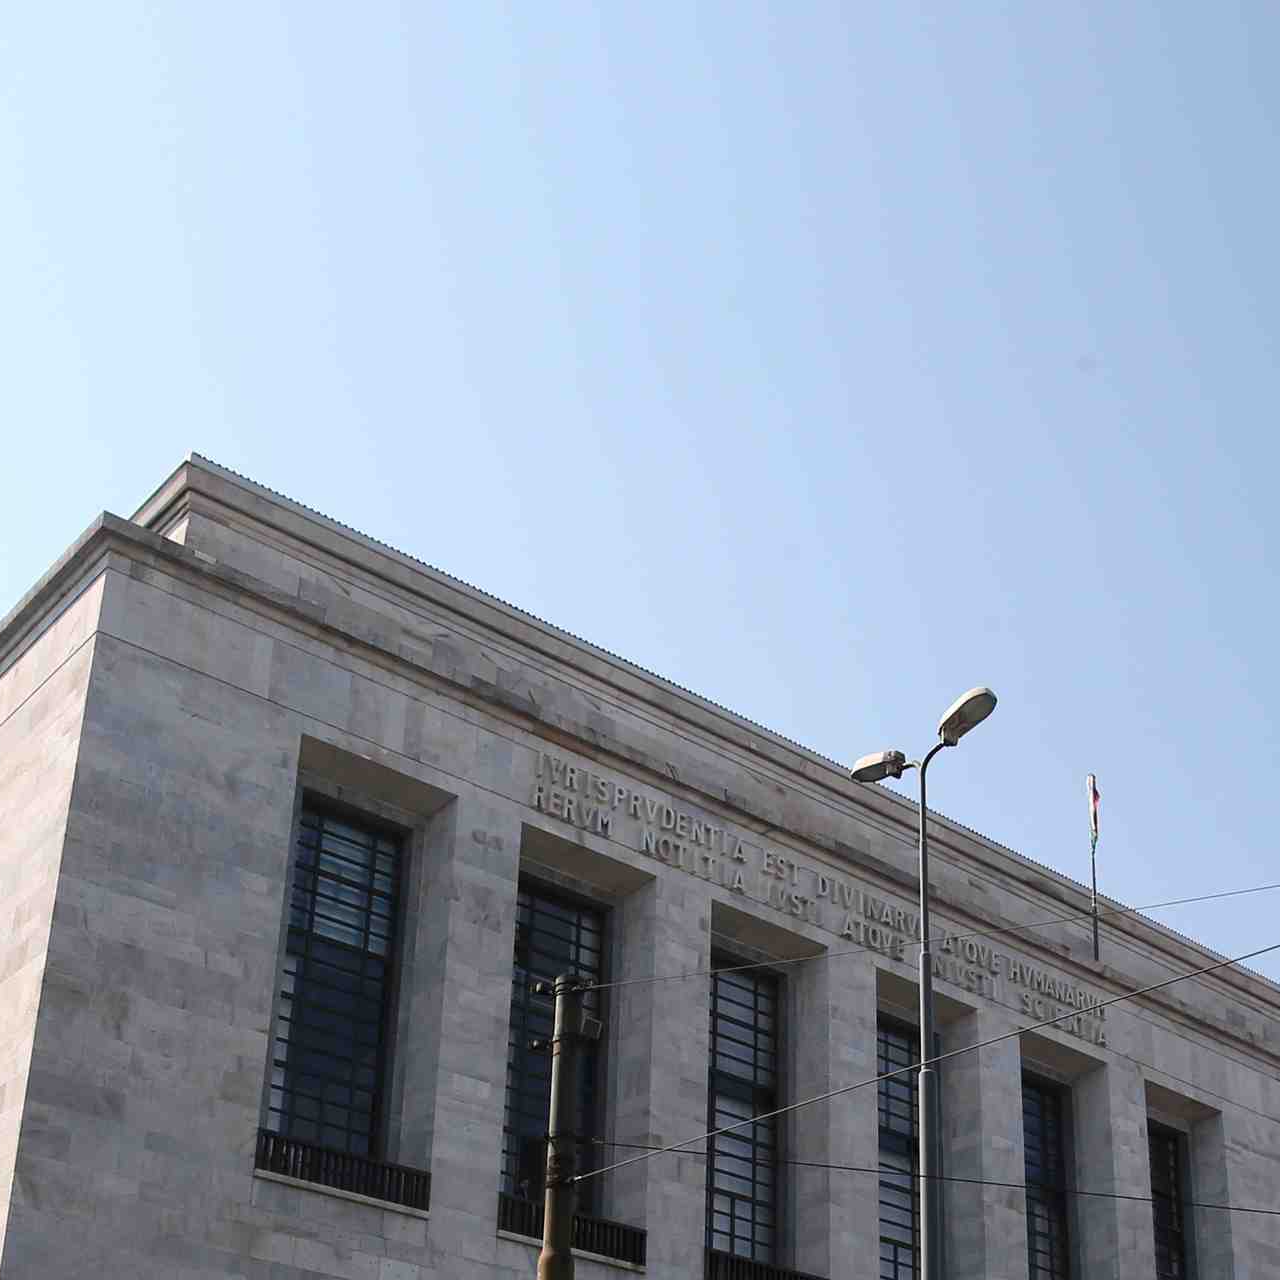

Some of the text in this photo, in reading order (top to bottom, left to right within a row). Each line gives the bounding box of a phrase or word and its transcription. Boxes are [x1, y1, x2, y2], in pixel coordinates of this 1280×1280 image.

[533, 784, 613, 837] RERVM
[642, 830, 746, 893] NOTITIA
[762, 850, 801, 887] EST
[818, 873, 932, 942] DIVINARV
